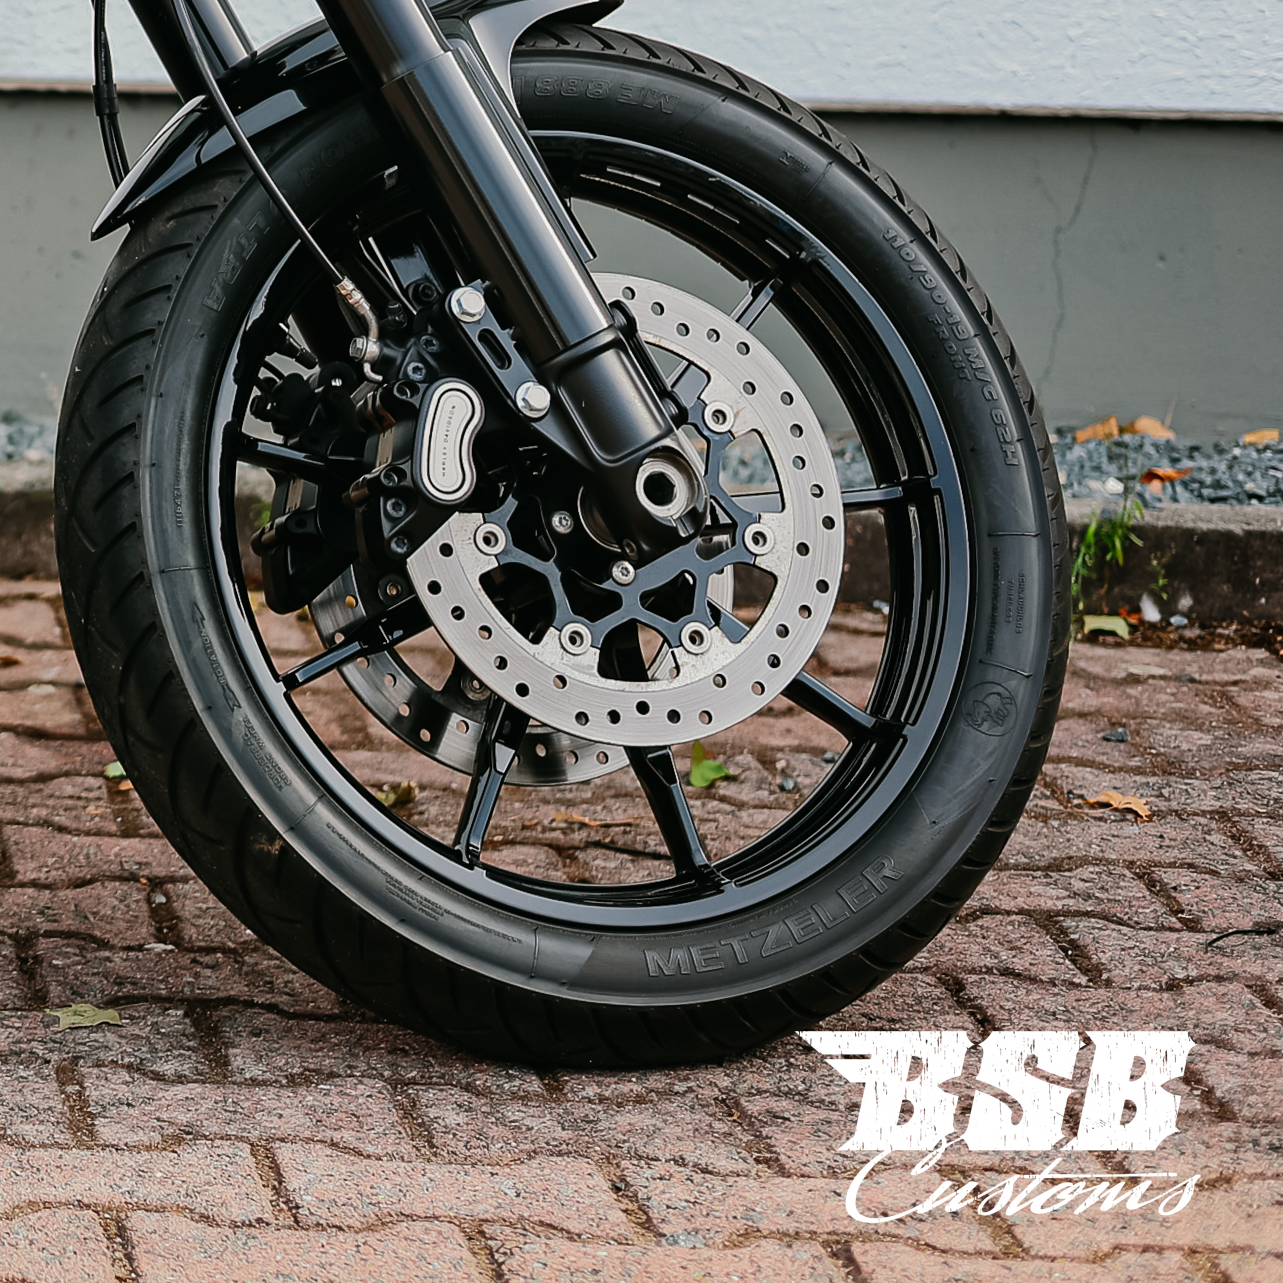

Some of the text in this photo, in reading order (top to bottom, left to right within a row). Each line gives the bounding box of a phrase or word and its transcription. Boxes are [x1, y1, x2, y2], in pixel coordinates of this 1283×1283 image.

[535, 74, 681, 114] ME 888
[882, 227, 1020, 469] 110/90-19 M/C 62H
[927, 312, 974, 383] FRONT
[199, 629, 228, 687] ROTATION
[643, 853, 905, 978] METZELER
